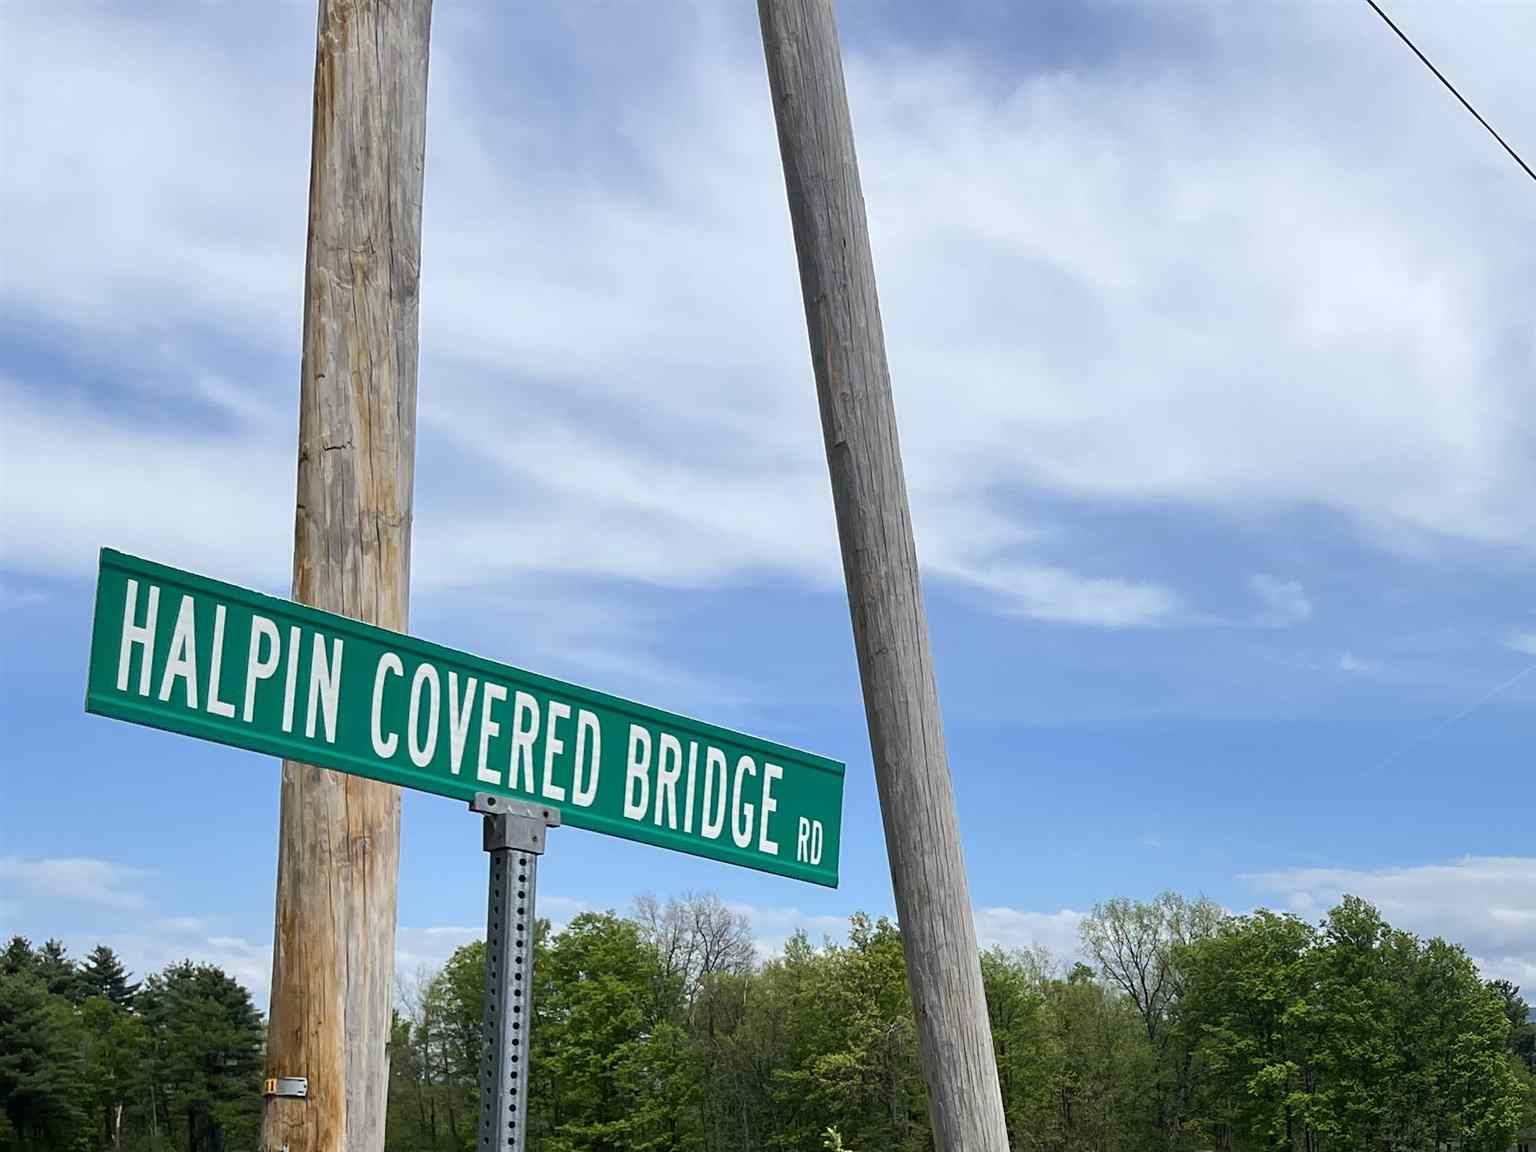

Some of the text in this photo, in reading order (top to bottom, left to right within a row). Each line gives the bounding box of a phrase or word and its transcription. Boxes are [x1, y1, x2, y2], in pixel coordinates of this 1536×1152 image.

[116, 579, 825, 866] HALPIN COVERED BRIDGE RD
